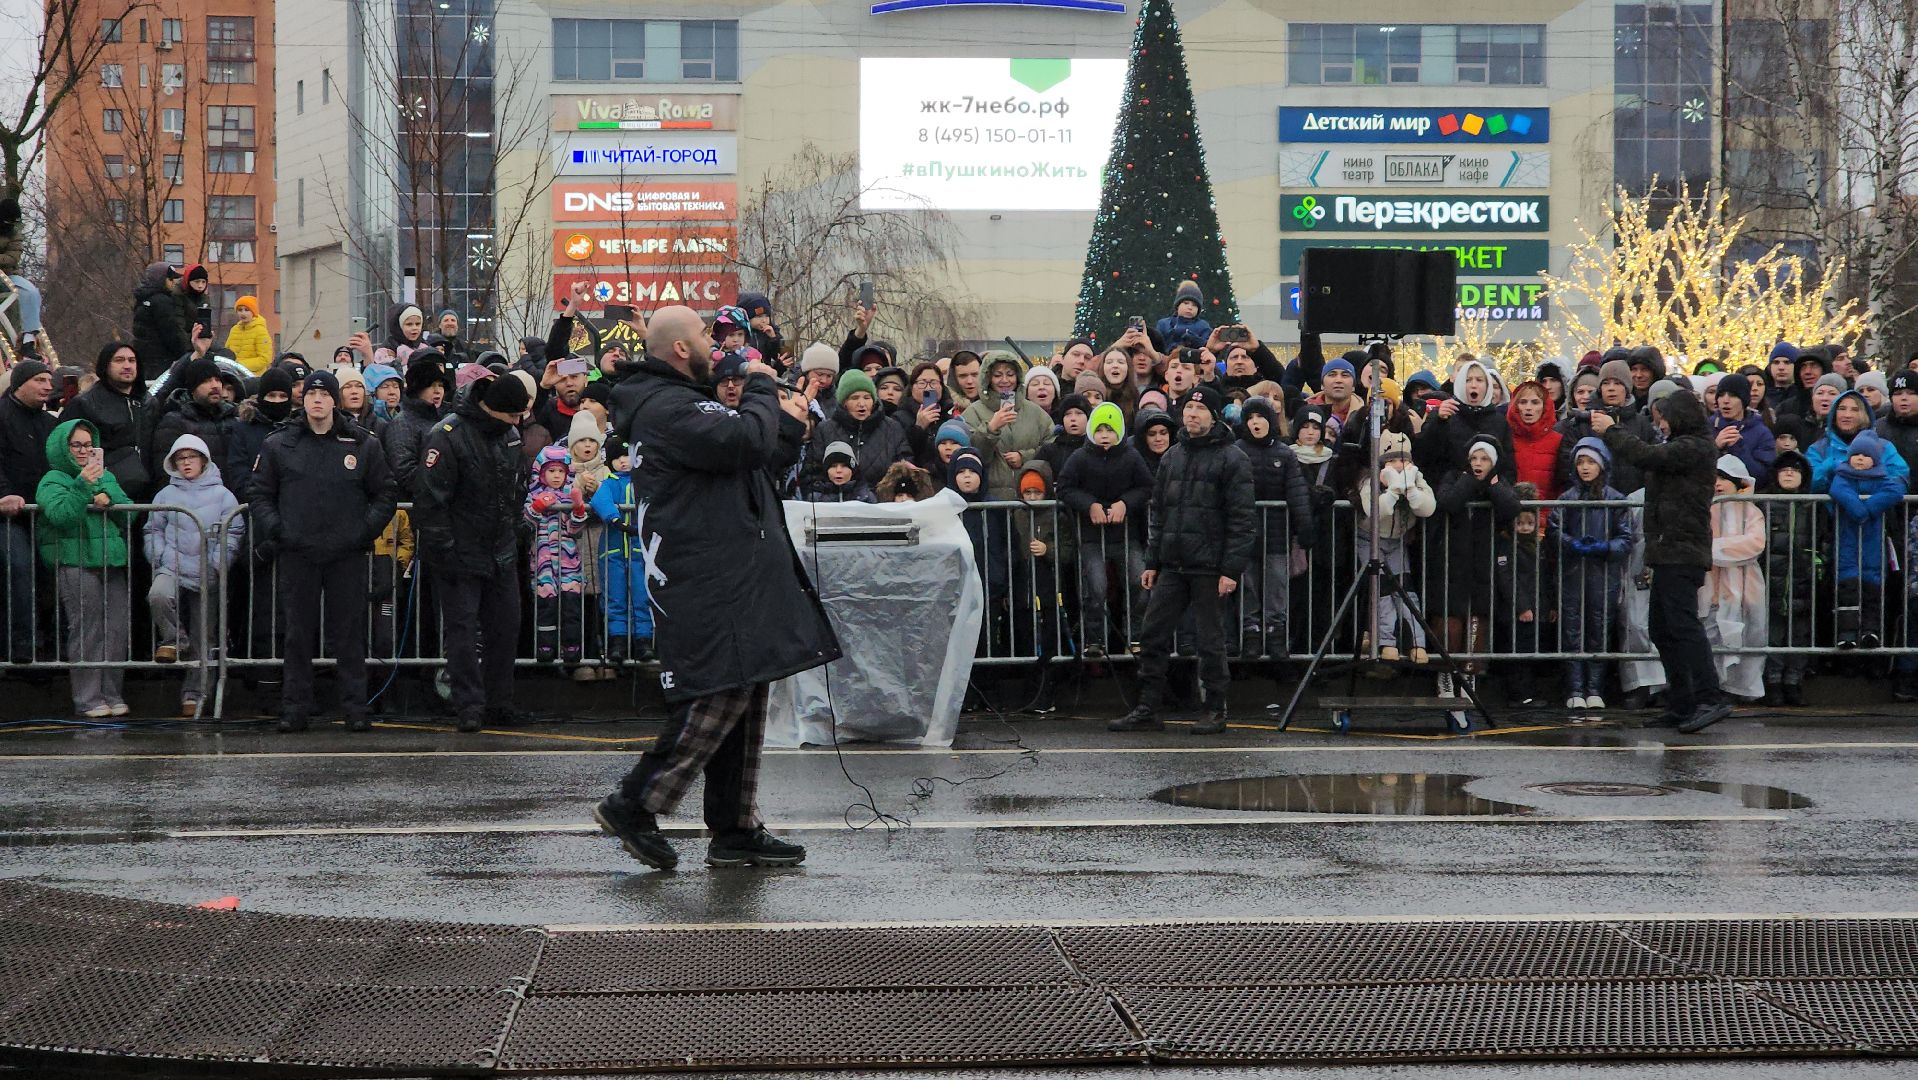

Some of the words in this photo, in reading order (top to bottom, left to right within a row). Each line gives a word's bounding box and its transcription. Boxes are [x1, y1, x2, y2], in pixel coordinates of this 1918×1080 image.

[577, 98, 622, 119] Viva
[658, 98, 713, 119] Roma
[920, 96, 1070, 118] жк-7небо.рф
[1303, 113, 1384, 131] Детский
[1389, 116, 1430, 136] мир
[918, 128, 929, 143] 8
[934, 127, 979, 145] (495)
[986, 128, 1072, 144] 150-01-11
[602, 145, 718, 165] ЧИТАЙ-ГОРОД
[1343, 157, 1374, 168] кино
[1459, 157, 1489, 168] кино
[902, 160, 1088, 181] #вПушкиноЖить
[1342, 170, 1375, 183] театр
[1390, 161, 1440, 177] ОБЛАКА
[1459, 169, 1489, 183] кафе
[564, 192, 635, 212] DNS
[637, 191, 690, 201] ЦИФРОВАЯ
[691, 191, 700, 200] И
[637, 201, 680, 211] БЫТОВАЯ
[683, 201, 725, 211] ТЕХНИКА
[1335, 196, 1540, 229] Перекресток
[599, 238, 668, 254] ЧЕТЫРЕ
[672, 238, 728, 254] ЛАПЫ
[572, 280, 721, 302] ОЗМАКС
[1456, 284, 1542, 306] DENT
